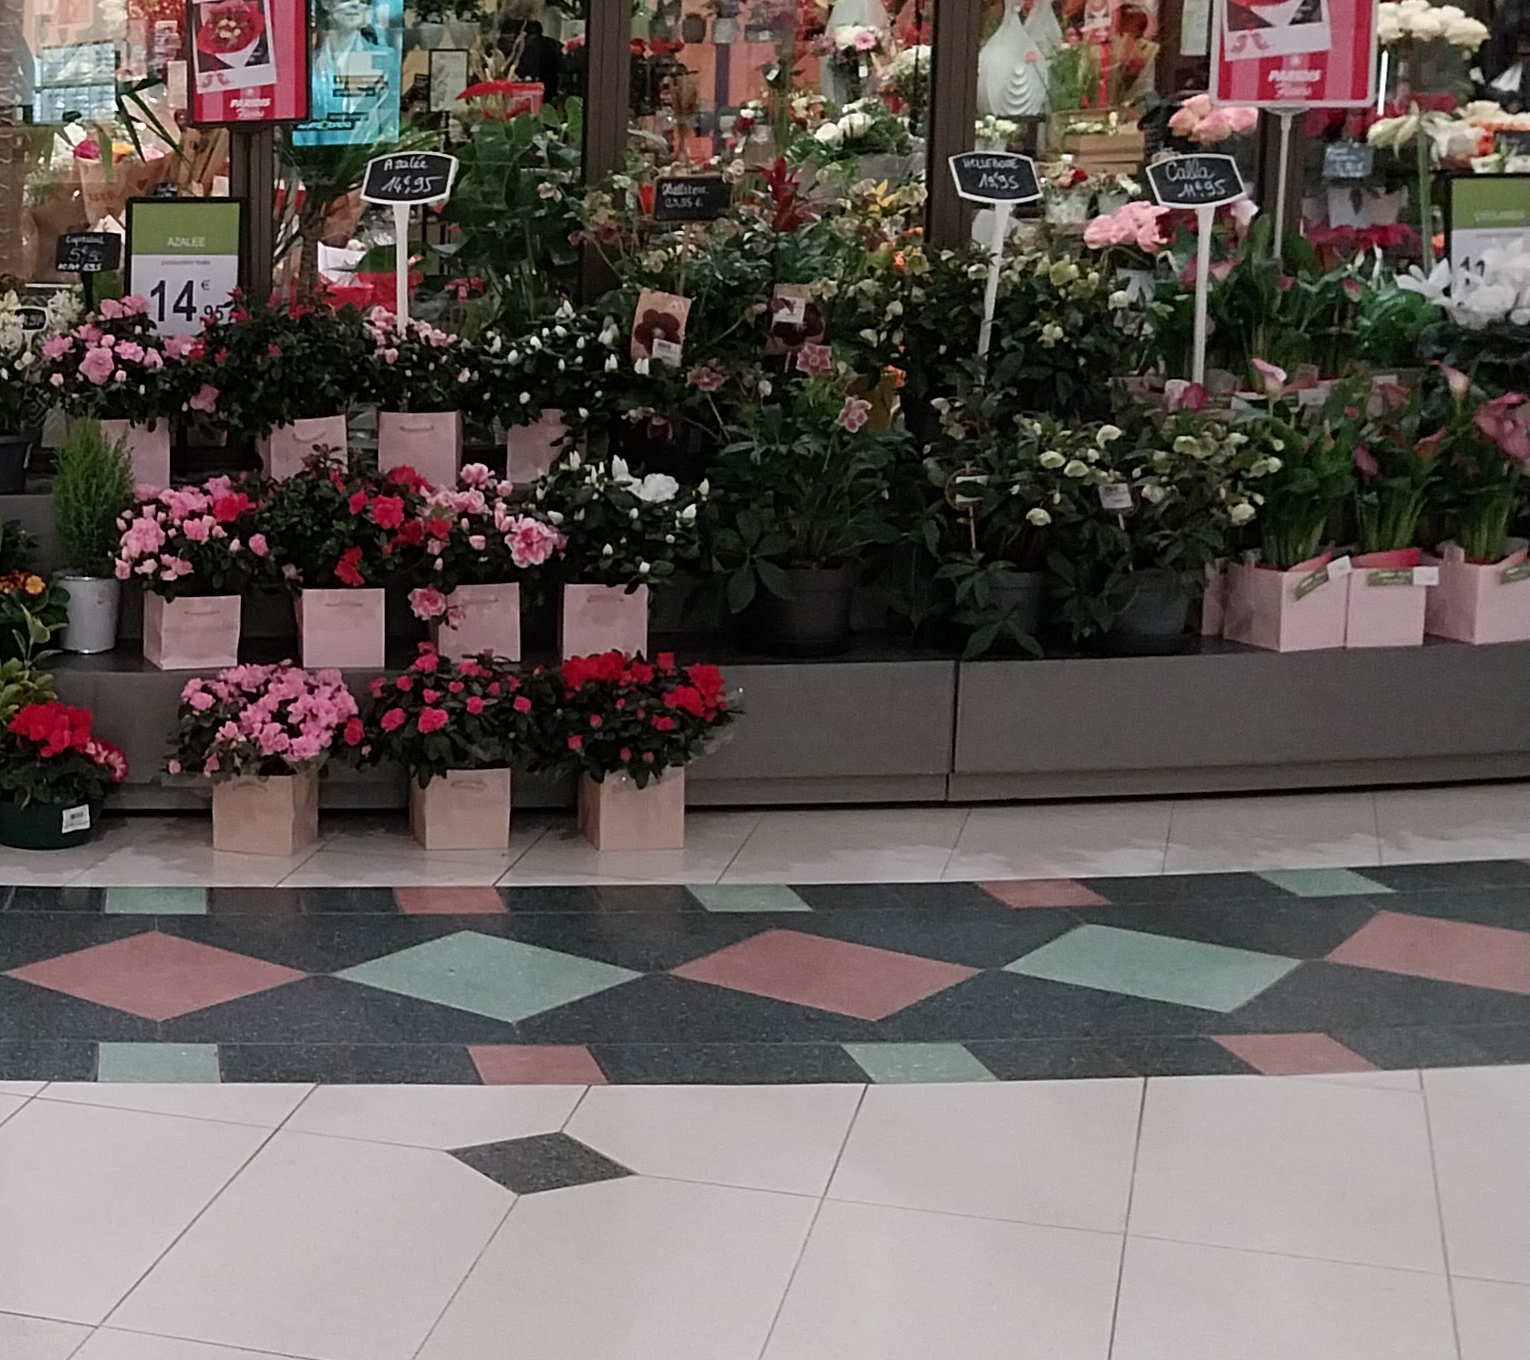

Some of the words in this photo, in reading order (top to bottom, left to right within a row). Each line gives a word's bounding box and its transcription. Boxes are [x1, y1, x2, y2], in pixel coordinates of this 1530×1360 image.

[384, 155, 428, 171] Azalée
[1166, 158, 1215, 182] Calla
[167, 236, 206, 247] AZALEE
[150, 280, 197, 322] 14
